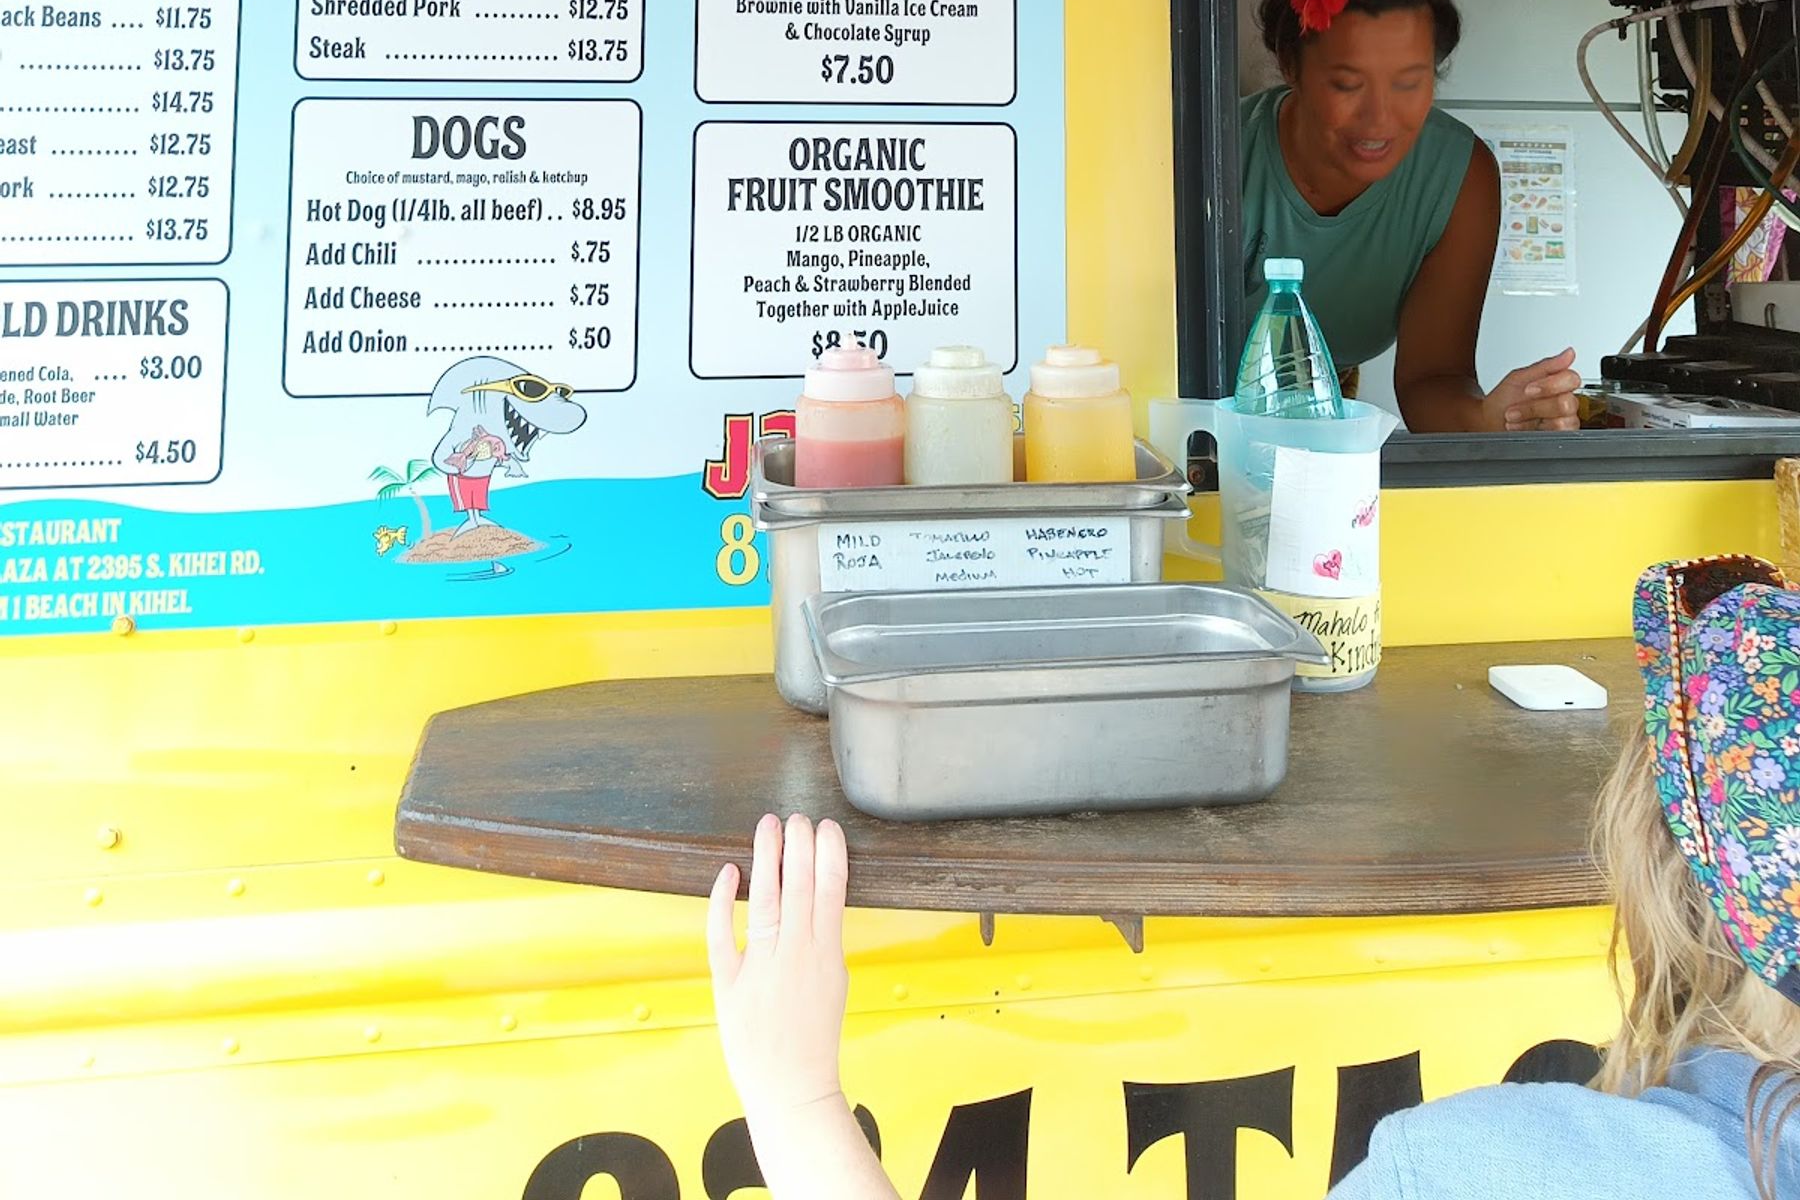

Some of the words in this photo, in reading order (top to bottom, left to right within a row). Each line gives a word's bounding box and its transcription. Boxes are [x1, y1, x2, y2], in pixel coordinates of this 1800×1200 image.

[41, 5, 101, 28] Beans
[156, 7, 211, 29] $11.75
[411, 115, 526, 160] DOGS
[789, 137, 926, 172] ORGANIC
[346, 170, 385, 184] Choice
[387, 171, 400, 184] of
[402, 171, 454, 185] mustard,
[456, 173, 490, 188] mayo,
[492, 170, 526, 184] relish
[529, 171, 540, 184] &
[543, 170, 588, 186] ketchup
[727, 177, 817, 212] FRUIT
[823, 177, 984, 212] SMOOTHIE
[307, 199, 342, 222] Hot
[347, 199, 386, 229] Dog
[392, 198, 455, 222] (1/4lb.
[461, 199, 486, 221] all
[492, 198, 542, 221] beef)
[572, 198, 626, 220] $8.95
[796, 225, 819, 243] 1/2
[824, 225, 844, 243] LB
[848, 225, 921, 242] ORGANIC
[744, 275, 790, 293] Peach
[795, 274, 810, 293] &
[813, 274, 904, 297] Strawberry
[909, 274, 971, 291] Blended
[55, 299, 189, 337] DRINKS
[302, 330, 343, 354] Add
[349, 329, 407, 353] Onion
[569, 326, 611, 349] $.50
[38, 366, 74, 382] Cola,
[140, 355, 202, 379] $3.00
[24, 388, 57, 404] Root
[61, 388, 96, 403] Beer
[34, 410, 79, 427] Water
[135, 439, 196, 464] $4.50
[836, 533, 882, 549] MILD
[53, 556, 85, 581] AT
[146, 553, 165, 579] S.
[168, 551, 227, 577] KIHEI
[230, 549, 265, 575] RD.
[25, 592, 99, 620] BEACH
[102, 591, 126, 616] IN
[1292, 607, 1368, 637] Mahalo
